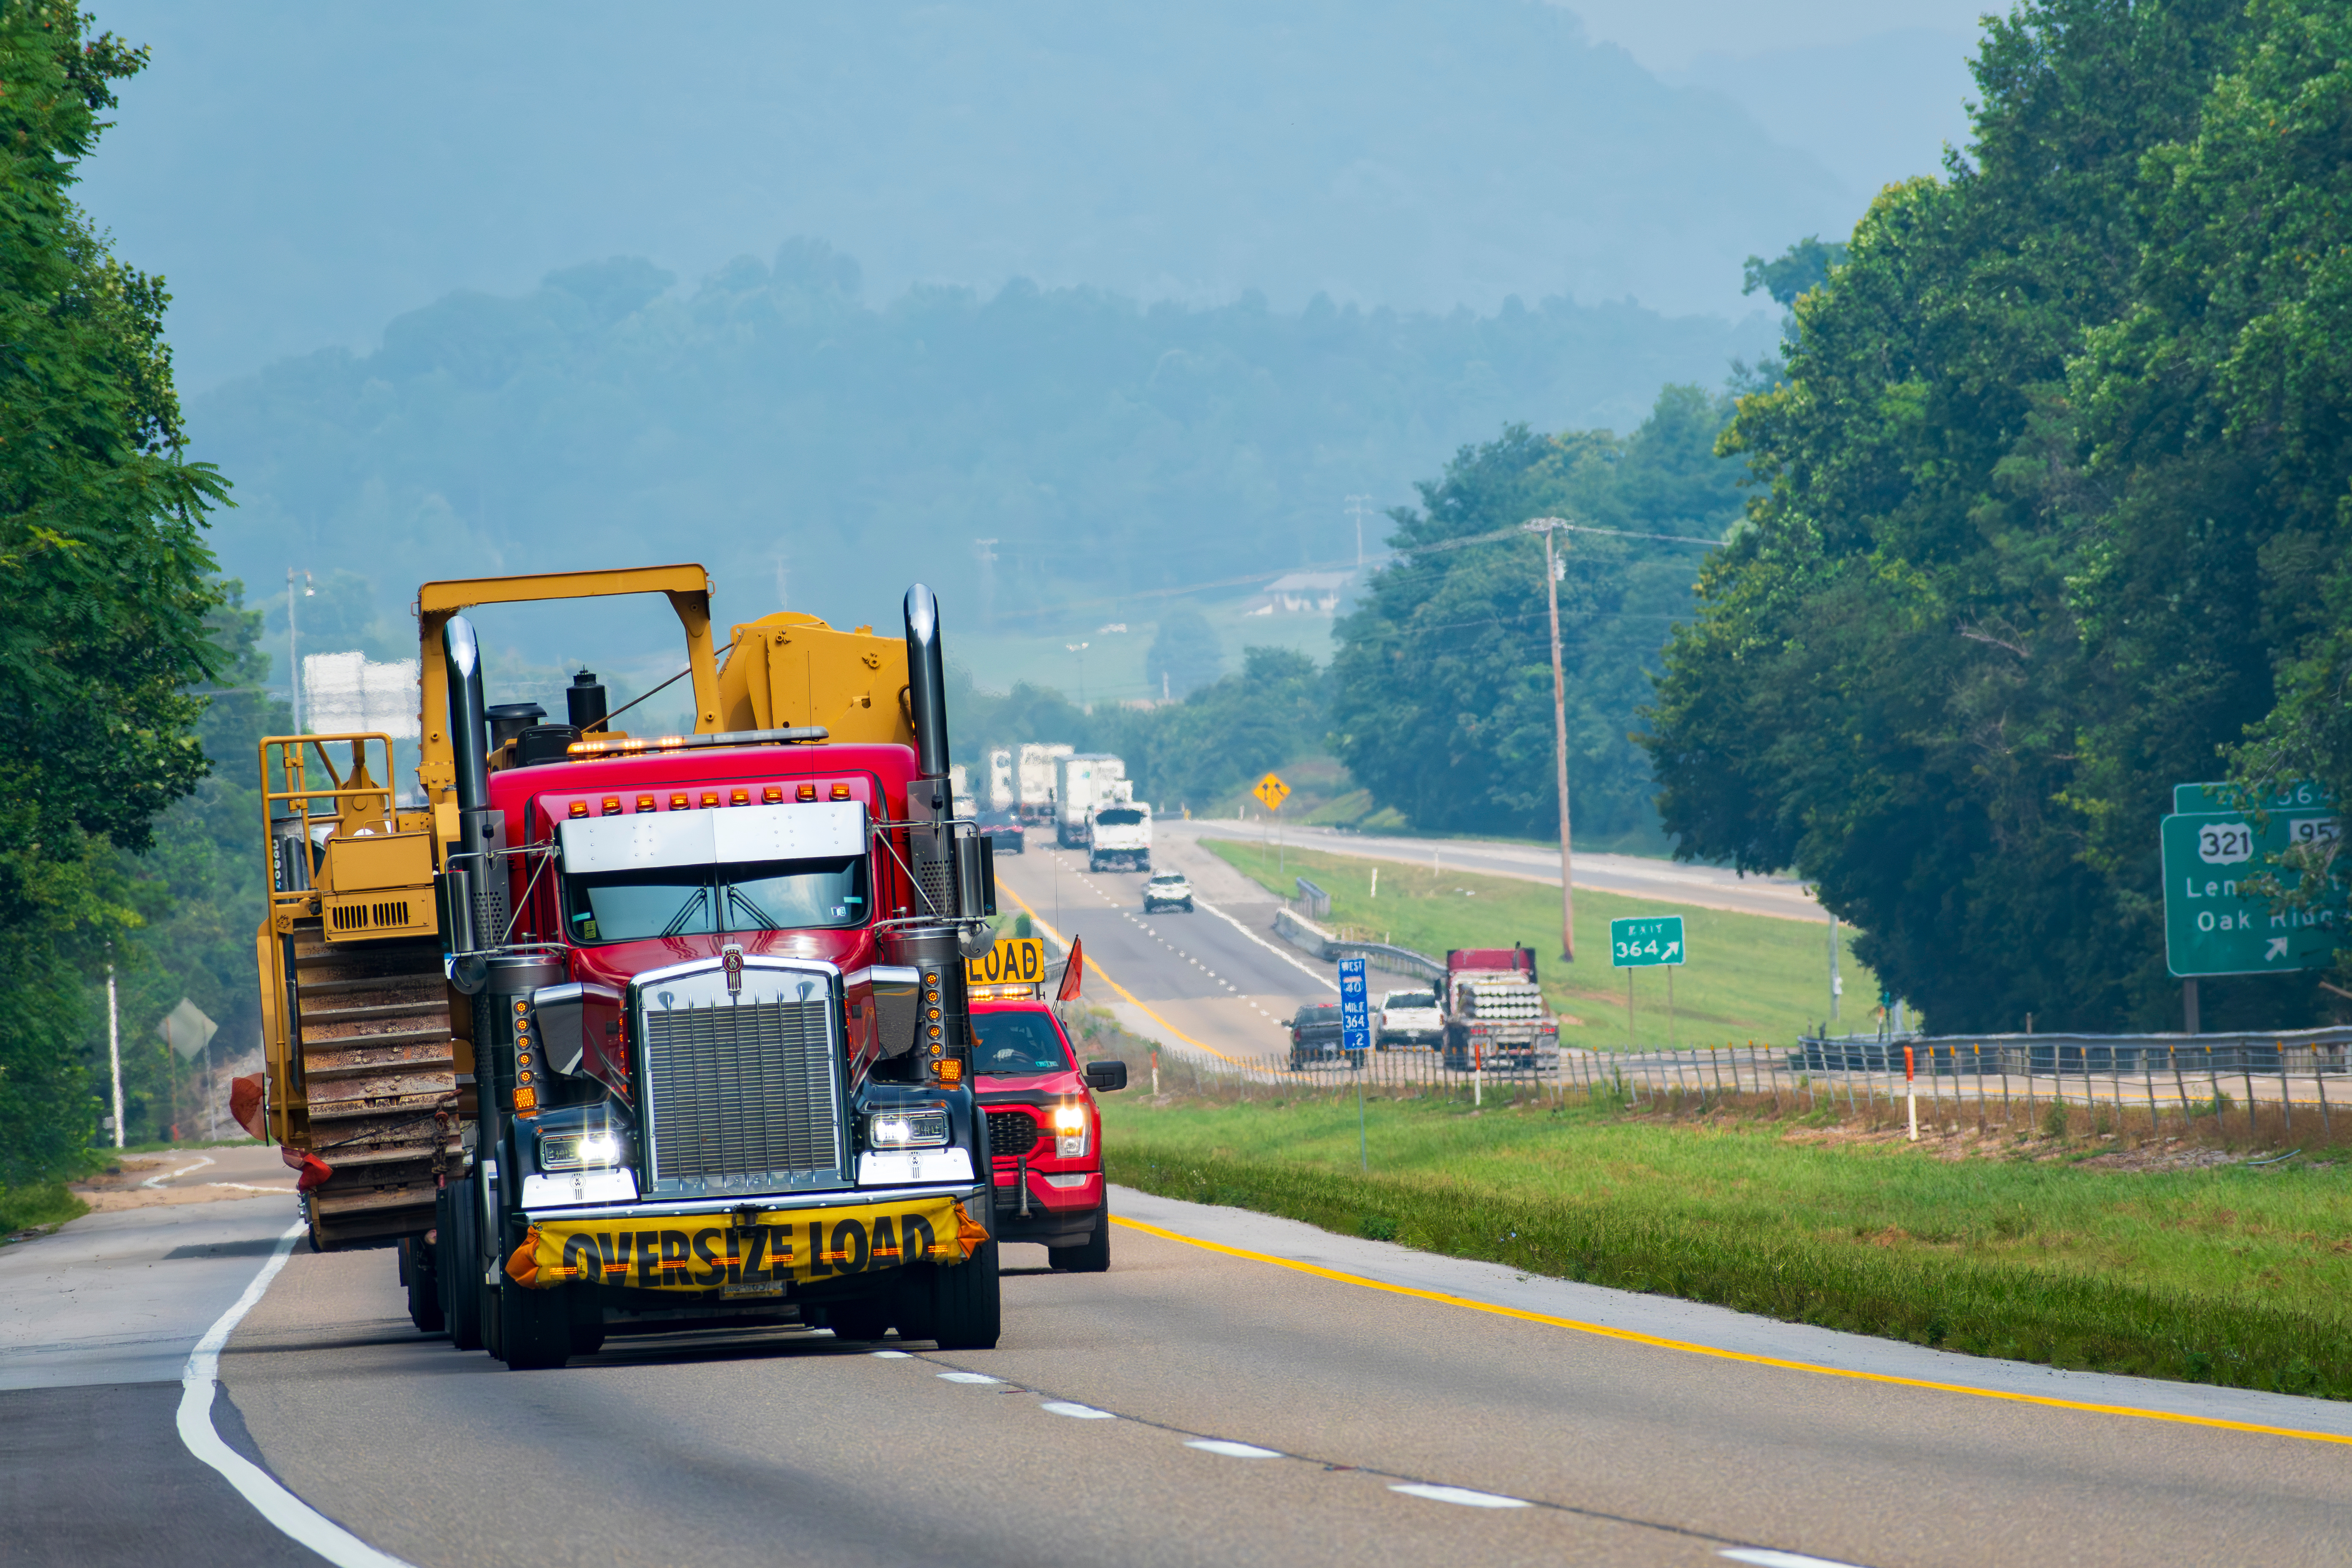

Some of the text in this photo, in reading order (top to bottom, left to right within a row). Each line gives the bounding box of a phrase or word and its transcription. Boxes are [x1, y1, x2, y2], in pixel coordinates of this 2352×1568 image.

[2299, 822, 2333, 845] 95
[2202, 831, 2248, 857] 321
[1628, 923, 1663, 936] EXIT
[2197, 909, 2251, 932] Oak
[1616, 939, 1660, 958] 364
[969, 942, 1037, 982] LOAD
[1341, 960, 1362, 972] WEST
[1345, 981, 1361, 993] 40
[1345, 1002, 1365, 1013] MILE
[1345, 1014, 1365, 1029] 364
[563, 1213, 935, 1288] OVERSIZE LOAD
